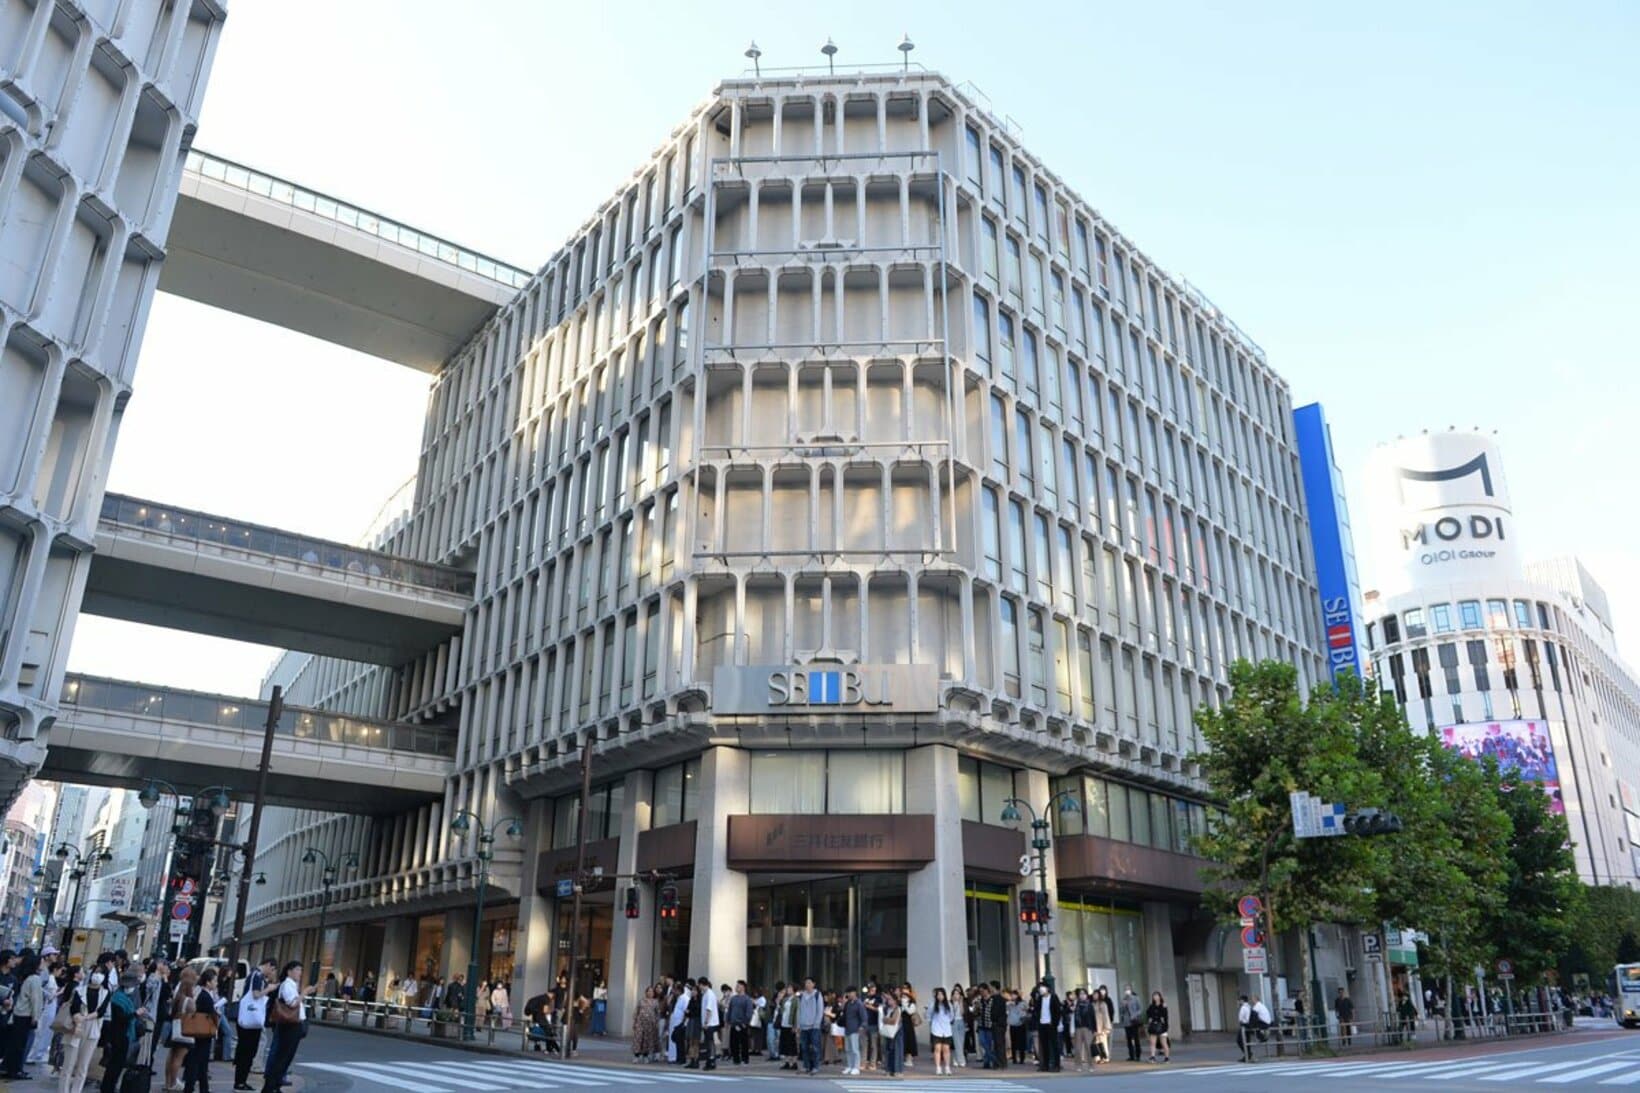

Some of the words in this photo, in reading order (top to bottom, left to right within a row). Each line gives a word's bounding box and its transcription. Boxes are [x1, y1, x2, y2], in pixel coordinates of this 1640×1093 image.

[1401, 515, 1505, 551] MODI
[768, 671, 893, 706] SEIBU
[1020, 854, 1032, 876] 3
[1363, 935, 1377, 952] P
